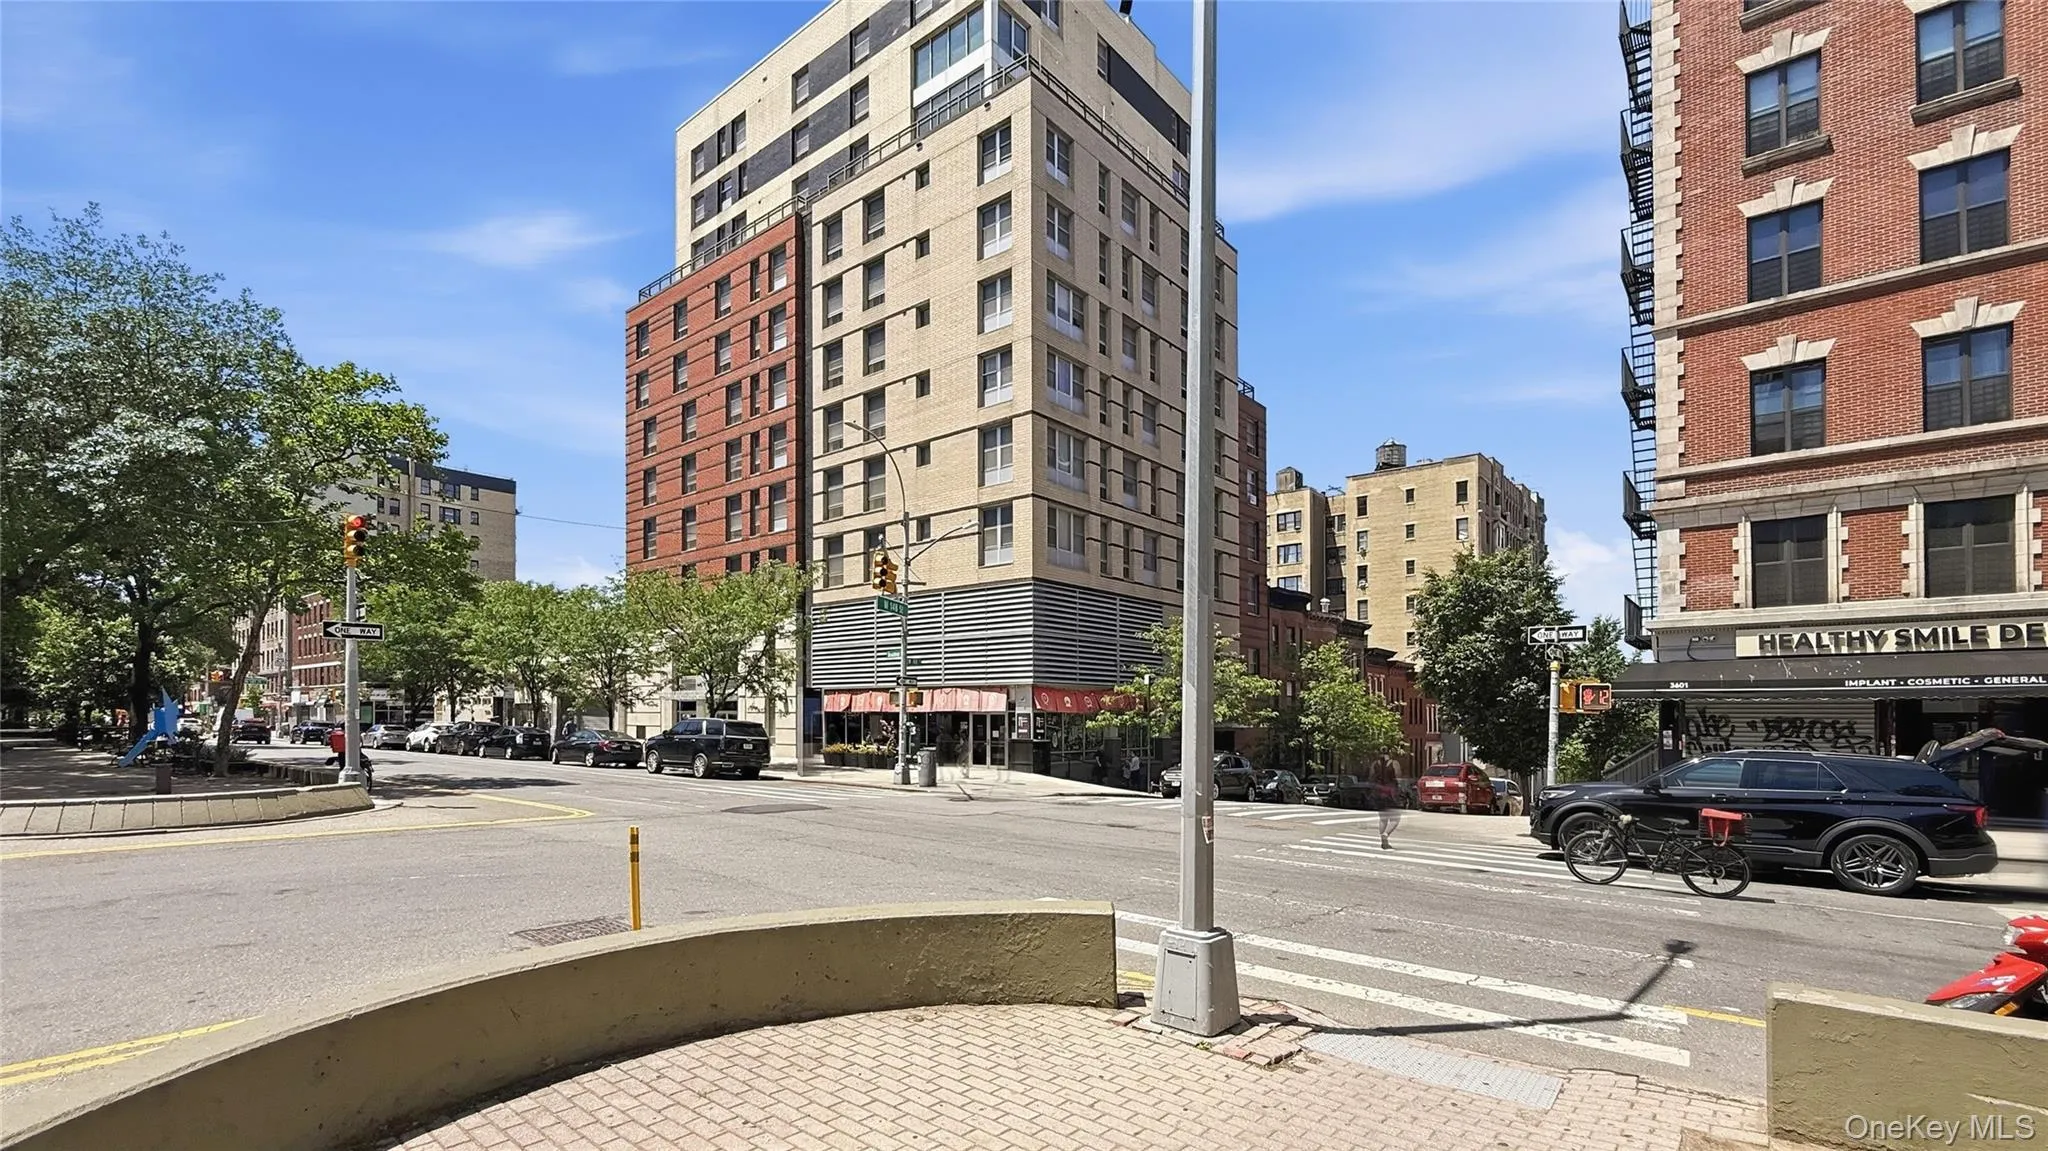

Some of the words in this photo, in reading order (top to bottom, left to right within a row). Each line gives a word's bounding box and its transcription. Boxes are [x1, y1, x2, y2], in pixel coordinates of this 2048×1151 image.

[334, 626, 350, 634] ONE
[1537, 631, 1553, 639] ONE
[1758, 629, 1886, 650] HEALTHY
[1894, 625, 1988, 647] SMILE
[1999, 622, 2045, 643] DE
[1844, 679, 1897, 687] IMPLANT
[1907, 677, 1970, 686] COSMETIC
[1984, 676, 2047, 684] GENERAL
[1600, 690, 1609, 705] 12
